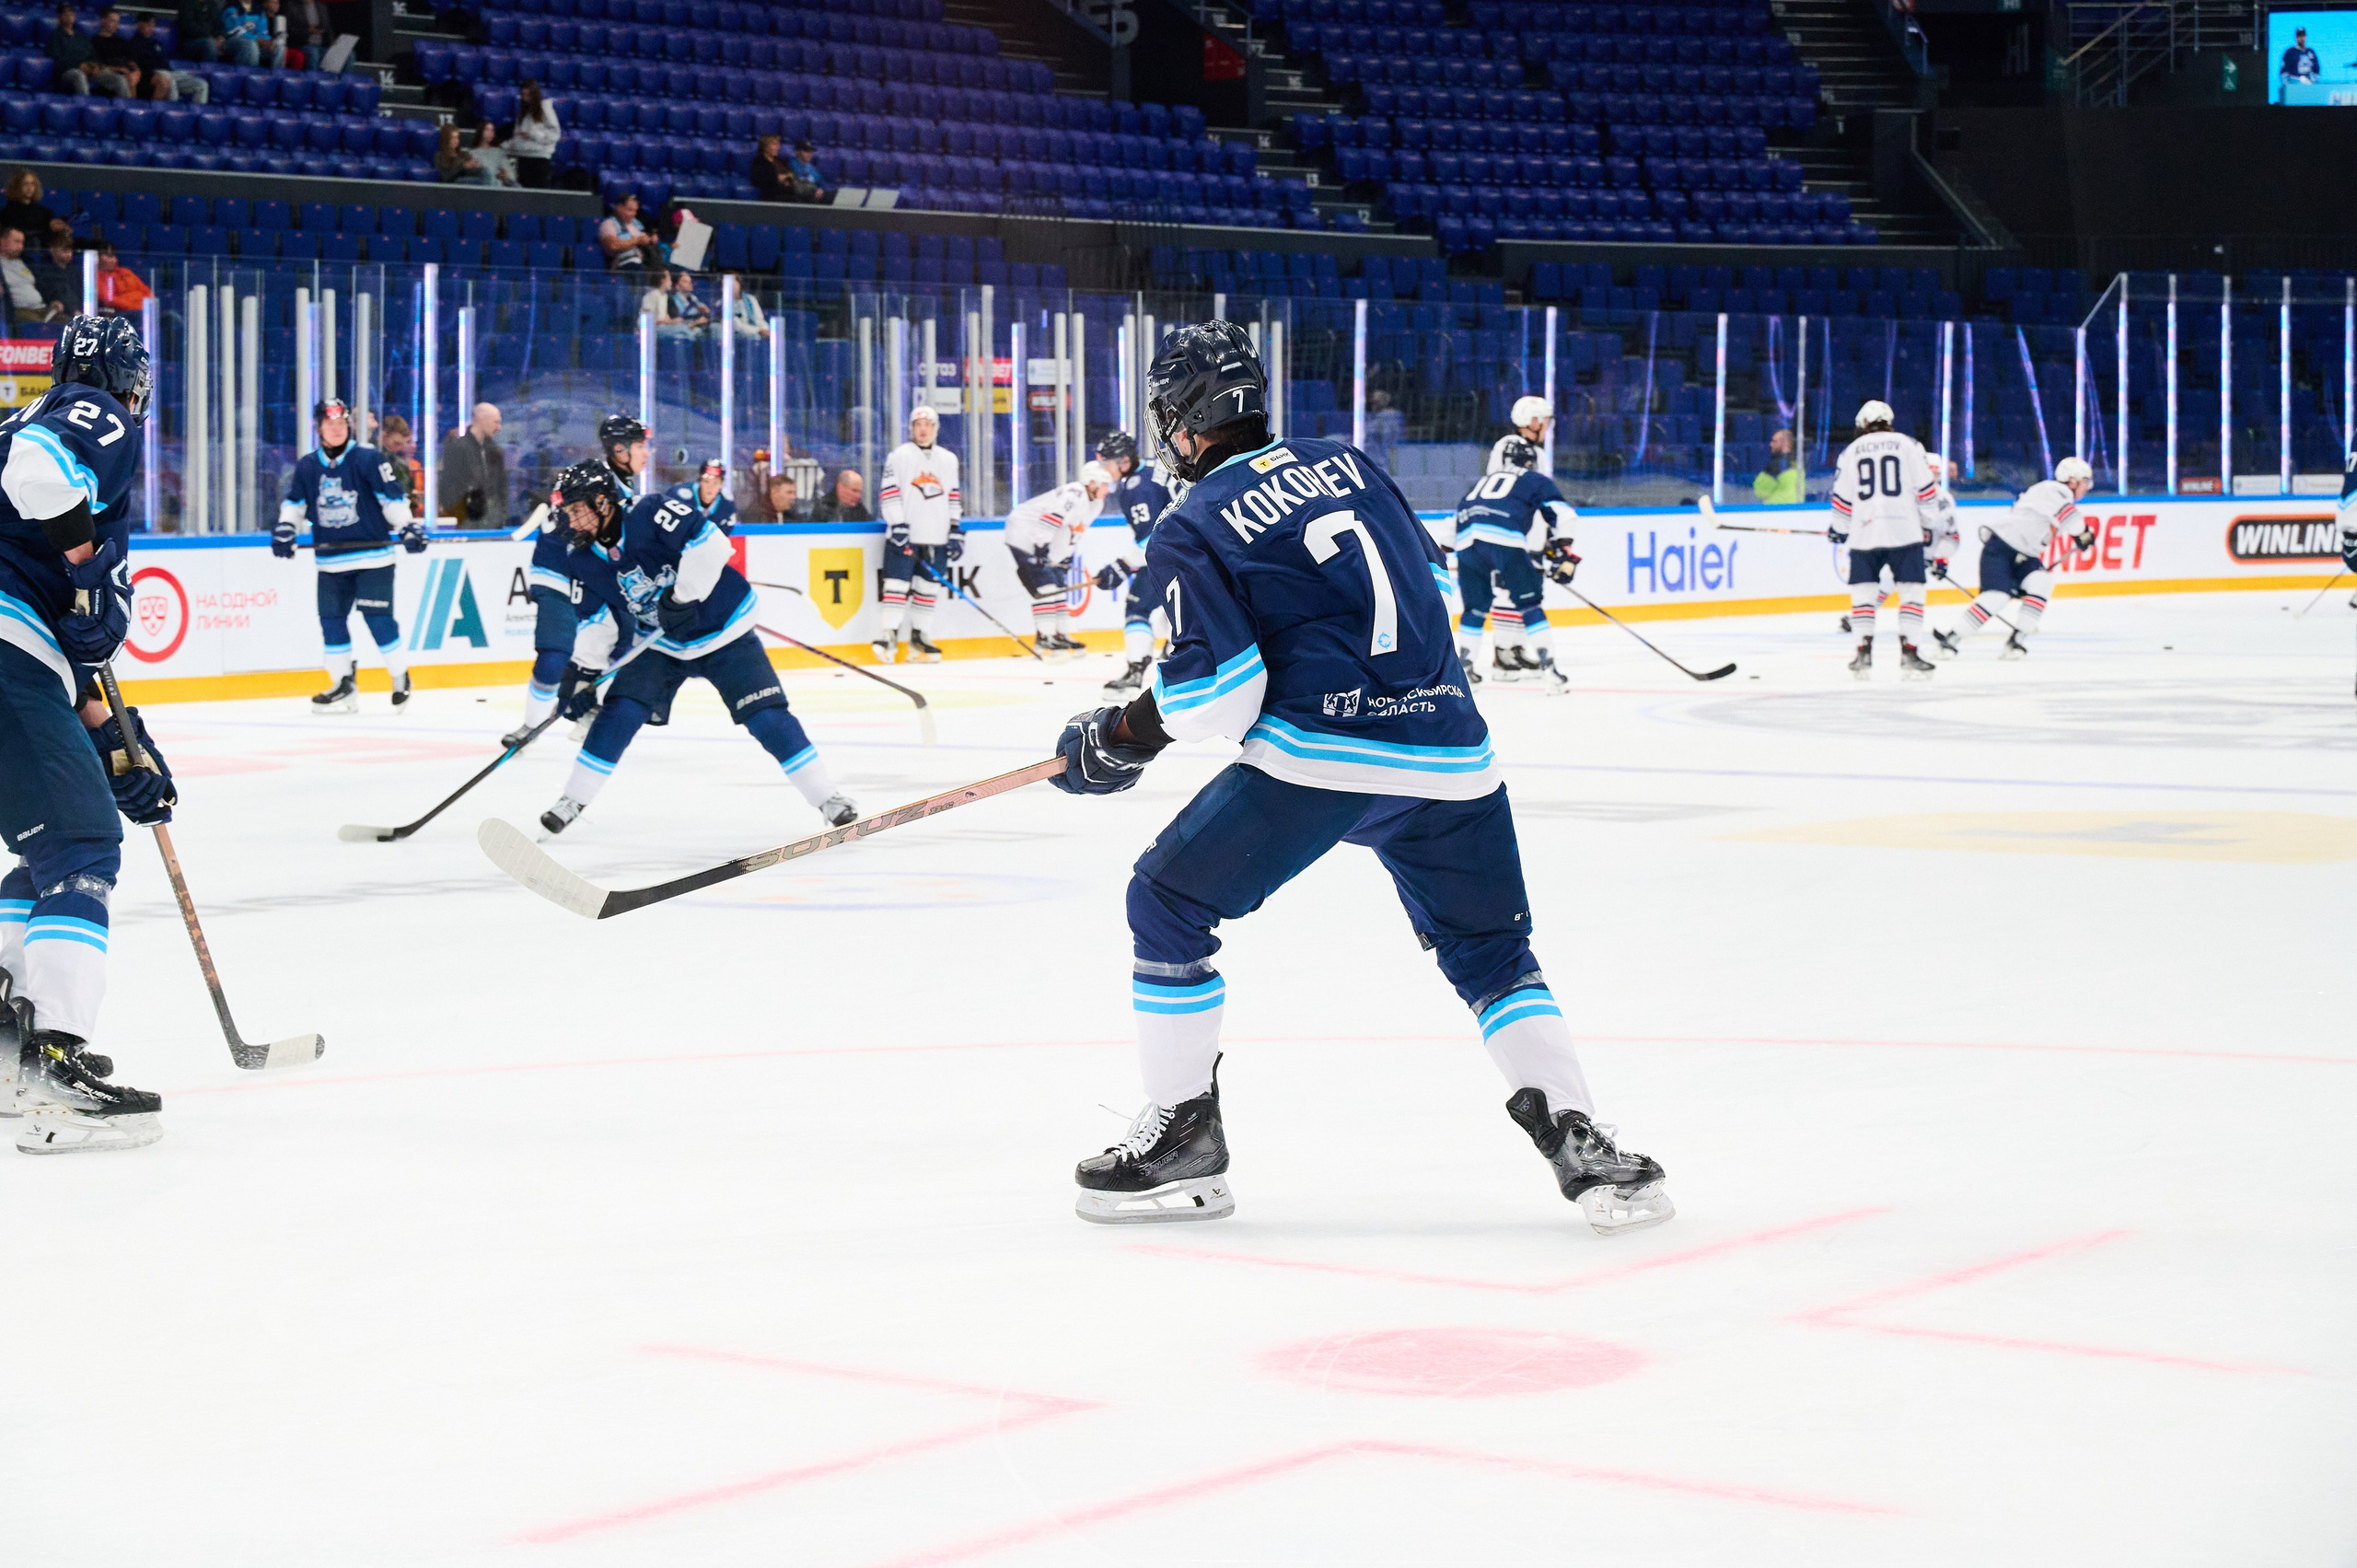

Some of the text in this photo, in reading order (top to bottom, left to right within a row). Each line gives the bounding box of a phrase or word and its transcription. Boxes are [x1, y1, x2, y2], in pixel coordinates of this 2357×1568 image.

[0, 345, 54, 365] ONBE
[73, 337, 99, 357] 27
[1232, 389, 1244, 413] 7
[67, 400, 126, 447] 27
[377, 461, 397, 483] 12
[1465, 471, 1518, 502] 10
[1857, 455, 1901, 501] 90
[1219, 452, 1366, 545] KOKOREV
[653, 498, 693, 533] 26
[1627, 525, 1738, 594] Haier
[195, 588, 279, 609] НА ОДНОЙ
[1303, 509, 1399, 657] 7
[195, 613, 250, 631] ЛИНИИ
[1165, 575, 1183, 638] 7
[17, 823, 45, 842] BAUER
[744, 800, 928, 873] SOYUZ
